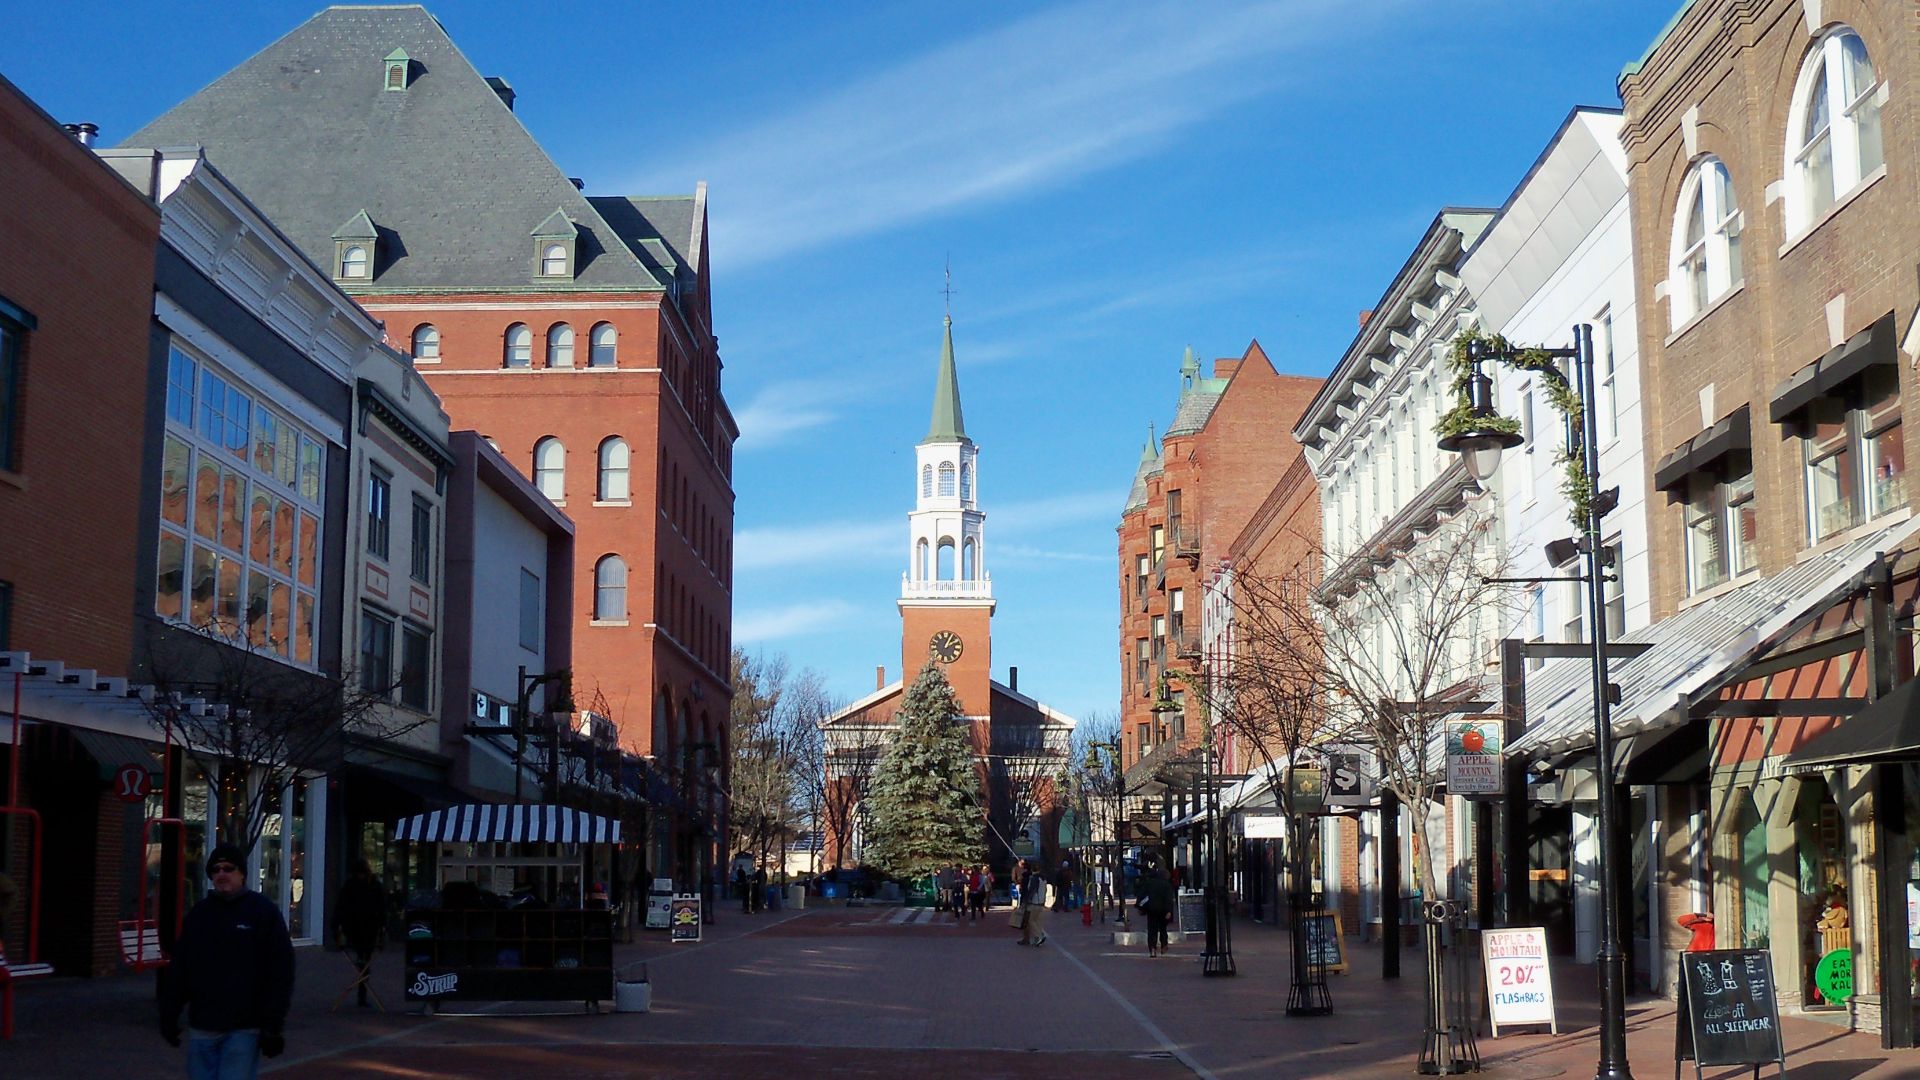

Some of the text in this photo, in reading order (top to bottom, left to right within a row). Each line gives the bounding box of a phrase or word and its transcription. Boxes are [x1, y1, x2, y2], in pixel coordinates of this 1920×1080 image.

[1458, 755, 1491, 765] APPLE
[1457, 766, 1492, 776] MOUNTAIN
[1490, 934, 1523, 946] APPLE
[1490, 945, 1542, 957] MOUNTAIN
[1500, 965, 1535, 986] 20%
[1732, 1002, 1745, 1018] off
[1706, 1017, 1771, 1034] ALL SLEEPWEAR
